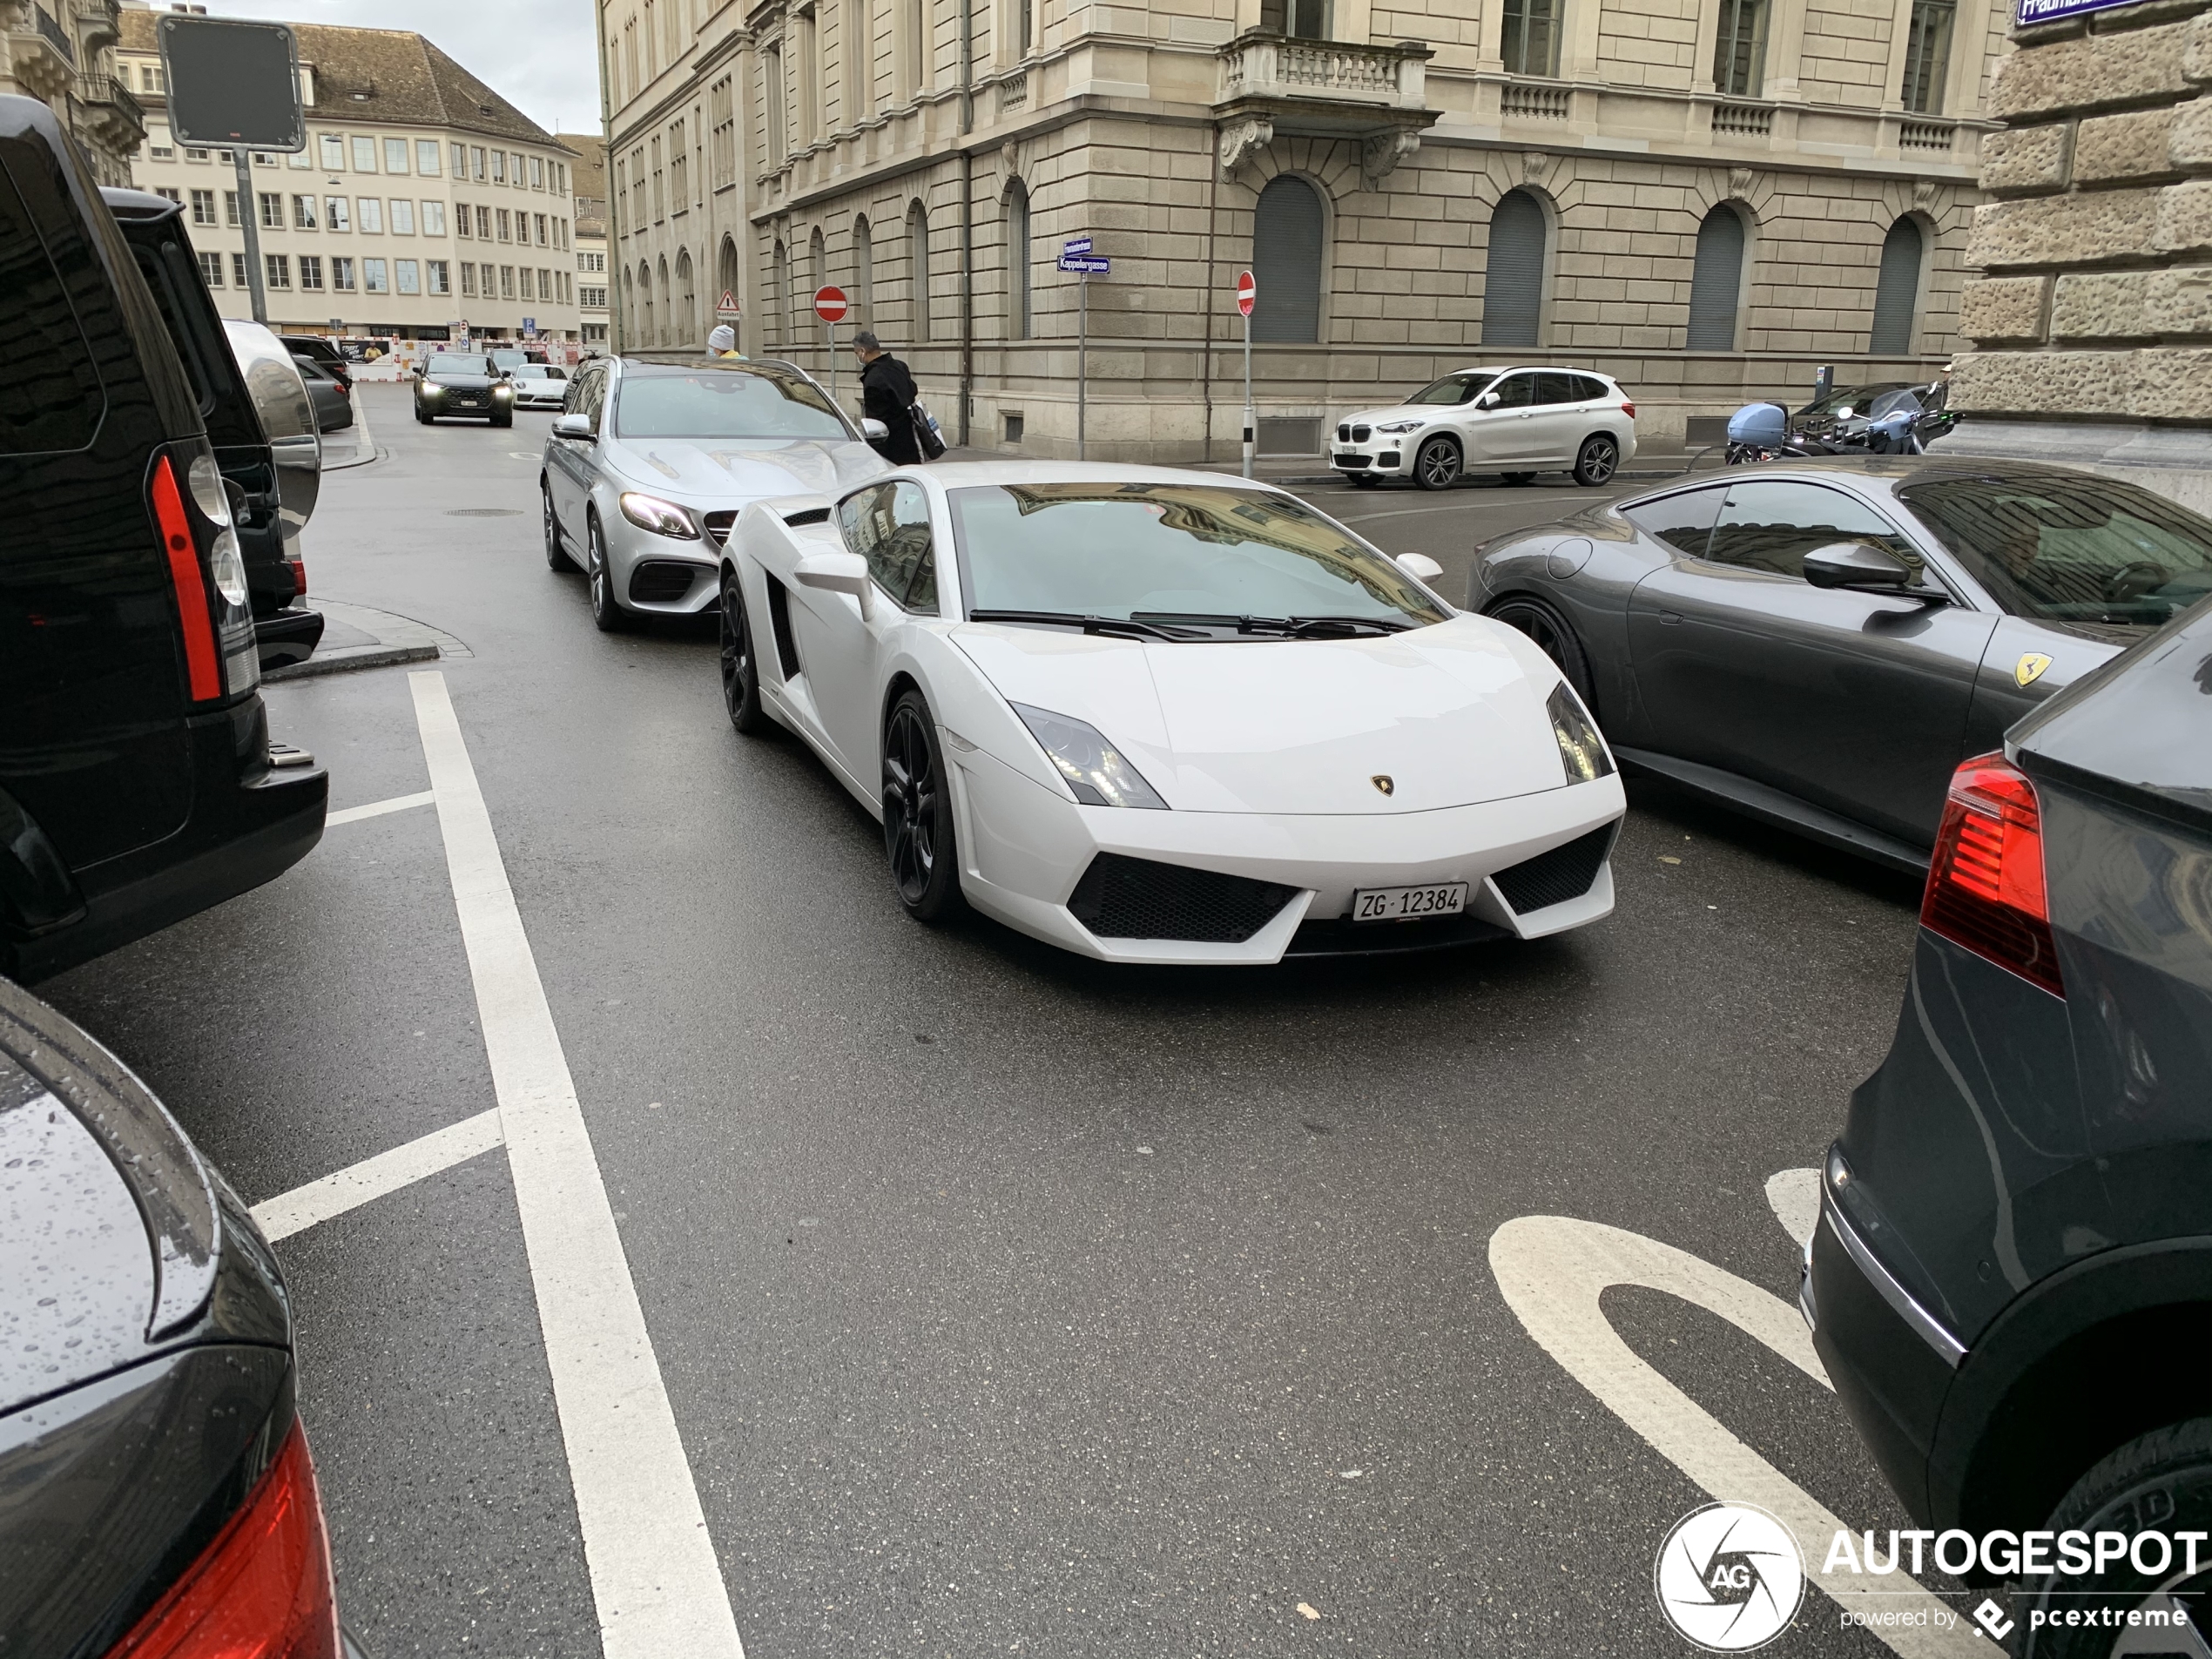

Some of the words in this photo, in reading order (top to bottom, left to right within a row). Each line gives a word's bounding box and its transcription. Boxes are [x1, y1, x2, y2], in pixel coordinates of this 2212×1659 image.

[1060, 258, 1108, 272] Kappelergasse
[1360, 894, 1386, 917] ZG
[1400, 888, 1458, 914] 12384
